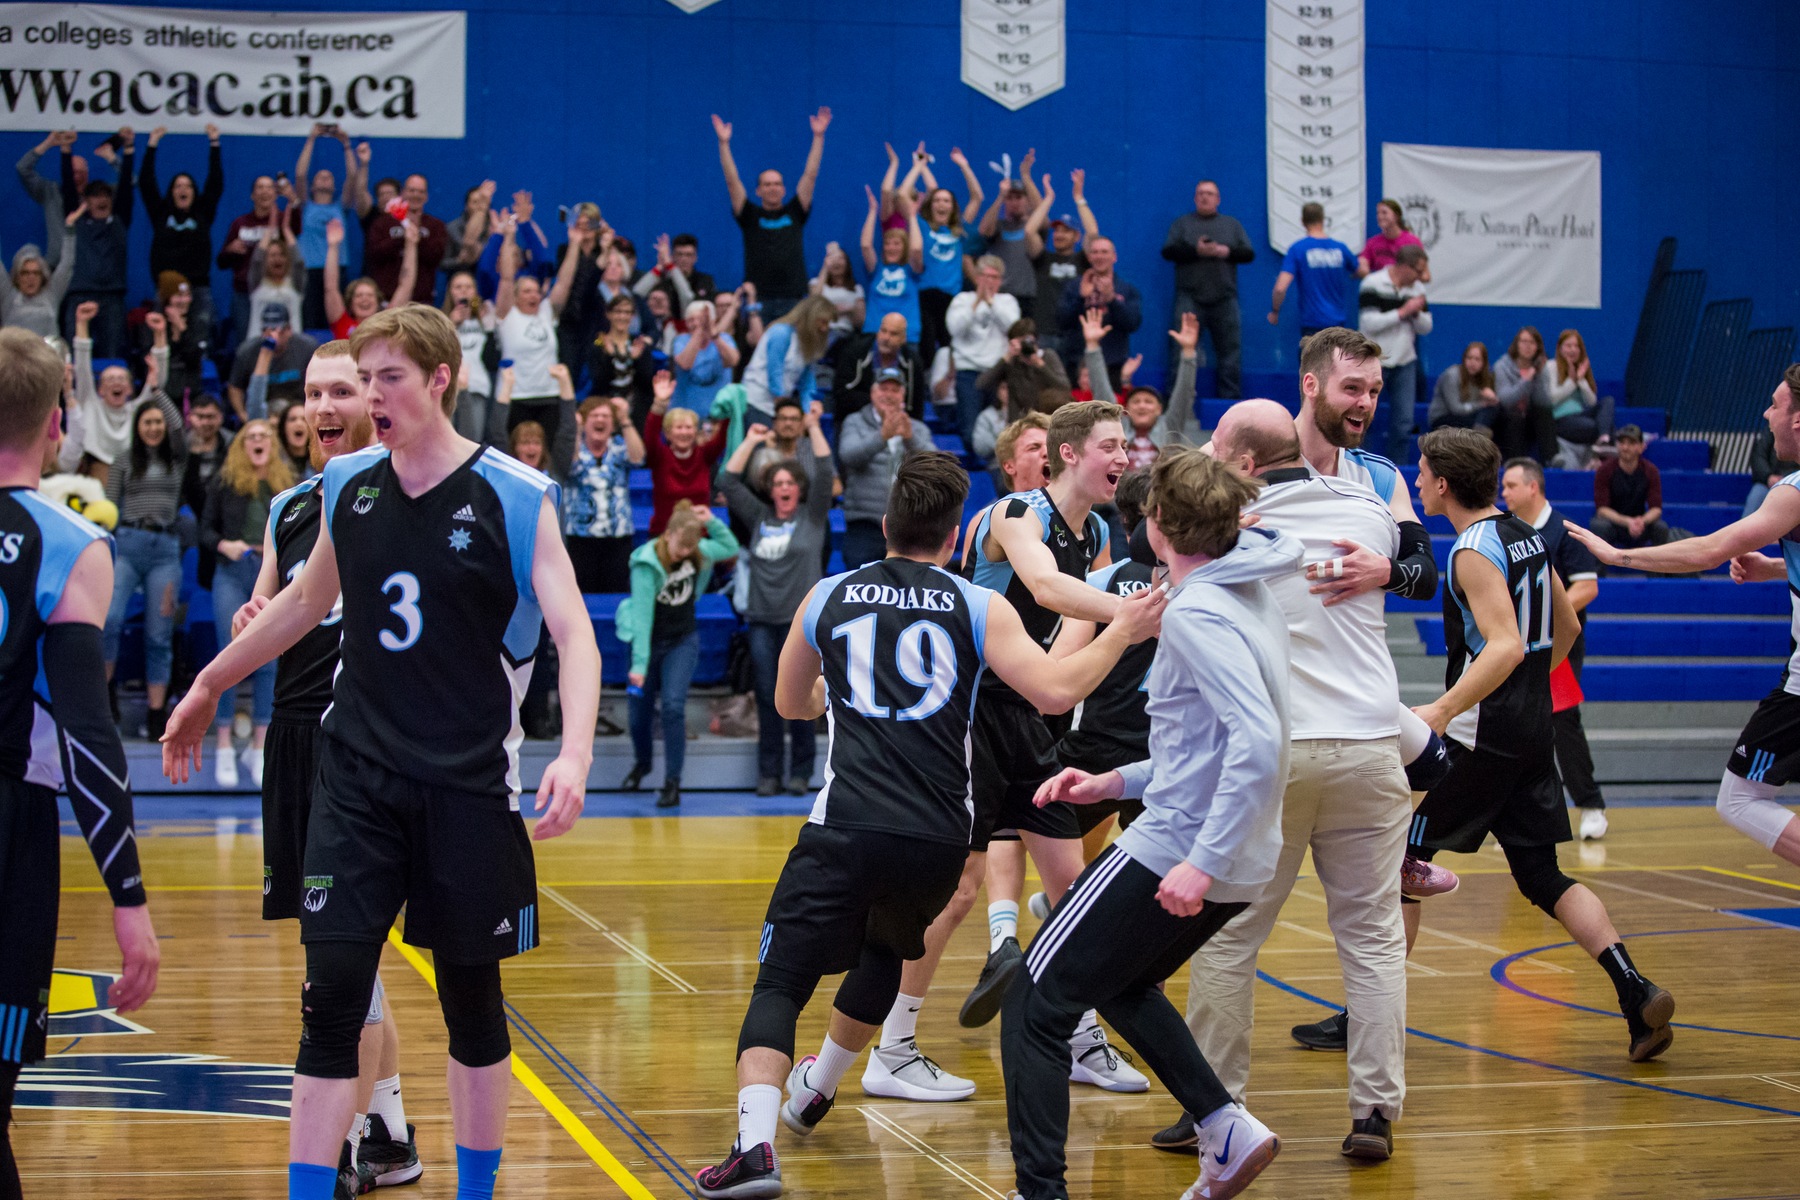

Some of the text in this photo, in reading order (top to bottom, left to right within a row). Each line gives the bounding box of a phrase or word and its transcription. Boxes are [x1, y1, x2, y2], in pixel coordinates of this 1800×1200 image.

[25, 21, 133, 50] colleges
[145, 25, 237, 48] athletic
[249, 28, 393, 51] conference
[996, 23, 1030, 35] 10/11
[997, 53, 1031, 65] 11/12
[994, 81, 1033, 95] 14/15
[1300, 125, 1333, 137] 11/12
[1300, 155, 1334, 167] 14-15
[1300, 186, 1334, 198] 15-16
[1451, 210, 1474, 234] The
[1117, 581, 1152, 597] KO
[842, 584, 955, 612] KODIAKS
[379, 571, 424, 652] 3
[1514, 560, 1553, 654] 11
[831, 612, 958, 721] 19
